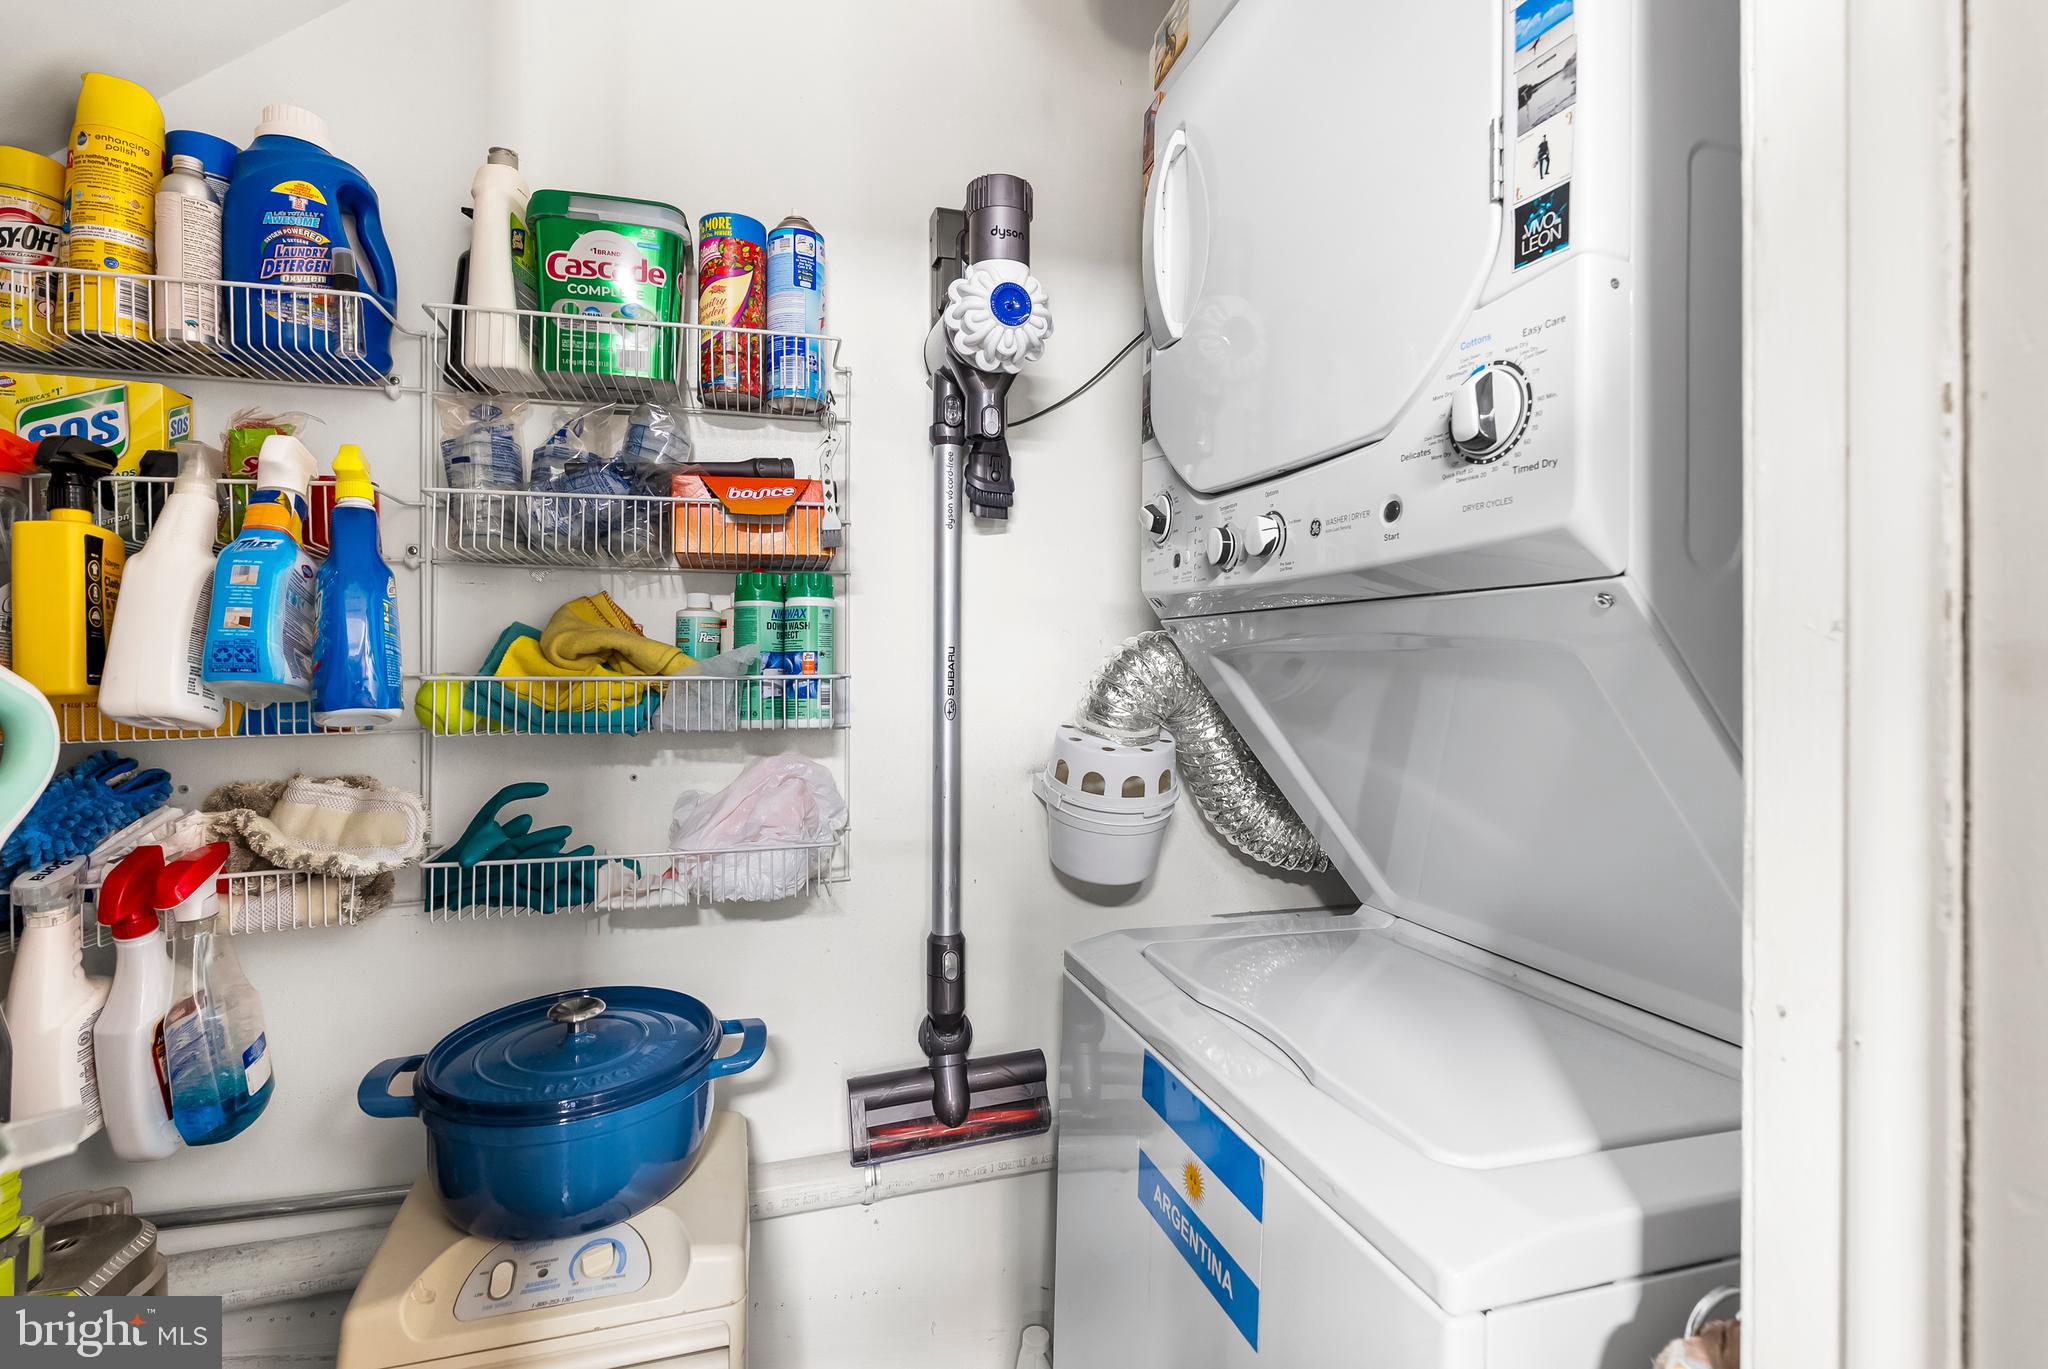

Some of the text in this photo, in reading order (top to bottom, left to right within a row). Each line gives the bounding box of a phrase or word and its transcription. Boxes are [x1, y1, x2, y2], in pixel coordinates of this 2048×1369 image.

[94, 133, 151, 156] enhancing
[105, 143, 137, 158] polish
[263, 211, 321, 229] AWESOME
[705, 216, 732, 231] MORE
[990, 225, 1025, 239] dyson
[1521, 223, 1562, 255] LEON
[274, 244, 328, 258] LAUNDRY
[261, 258, 333, 279] DETERGEN
[1522, 315, 1567, 337] Easy Care
[1460, 334, 1492, 351] Cottons
[15, 392, 51, 405] AMERICA'S
[28, 409, 120, 446] SOS
[170, 416, 190, 439] SOS
[1400, 448, 1431, 462] Delicates
[1512, 458, 1558, 474] Timed Dry
[727, 487, 796, 500] bounce
[1462, 496, 1514, 513] DRYER CYCLES
[946, 502, 956, 530] dyson
[1351, 510, 1370, 521] DRYER
[1383, 532, 1400, 542] Start
[788, 621, 810, 630] WASH
[947, 646, 955, 696] SUBARU
[1153, 1184, 1233, 1300] ARGENTINA
